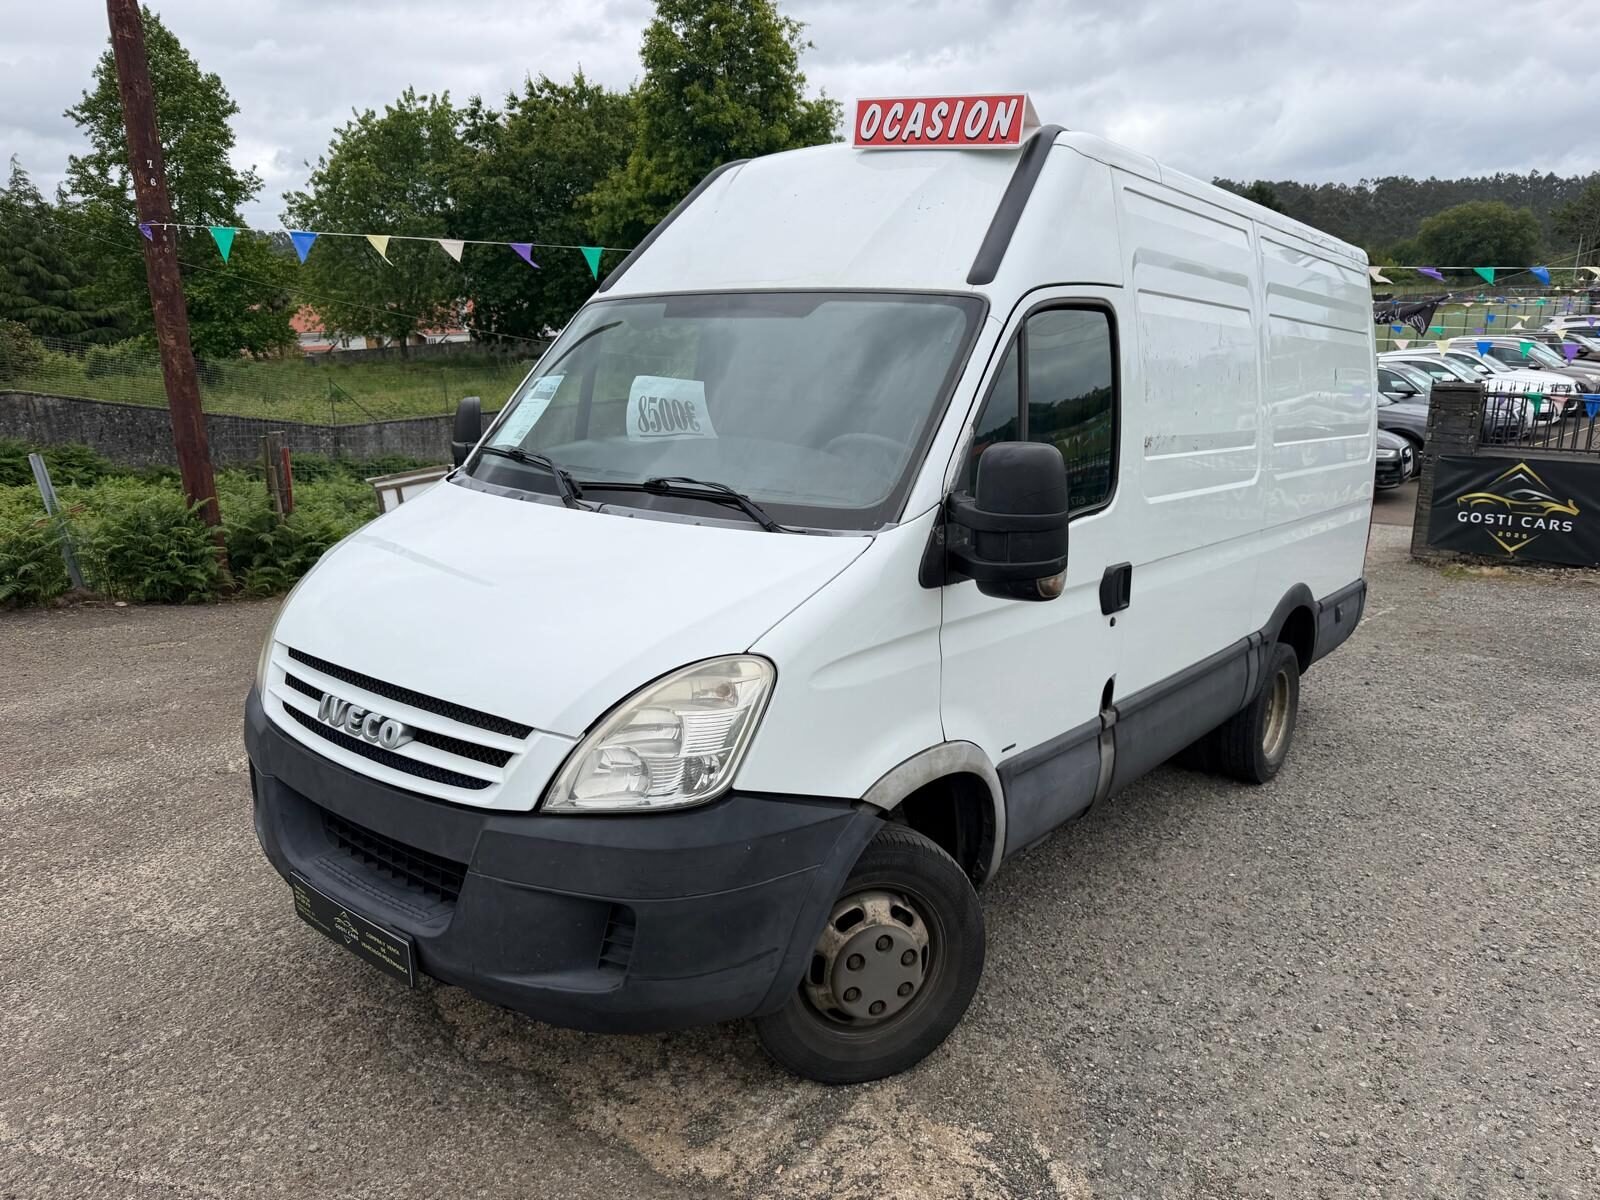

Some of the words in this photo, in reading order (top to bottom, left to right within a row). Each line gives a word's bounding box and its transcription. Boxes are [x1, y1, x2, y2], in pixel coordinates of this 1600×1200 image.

[860, 98, 1018, 141] OCASION
[146, 159, 153, 169] 7
[638, 395, 701, 433] 8500€
[1457, 511, 1513, 526] GOSTI
[1520, 516, 1573, 532] CARS
[318, 693, 404, 750] IVECO
